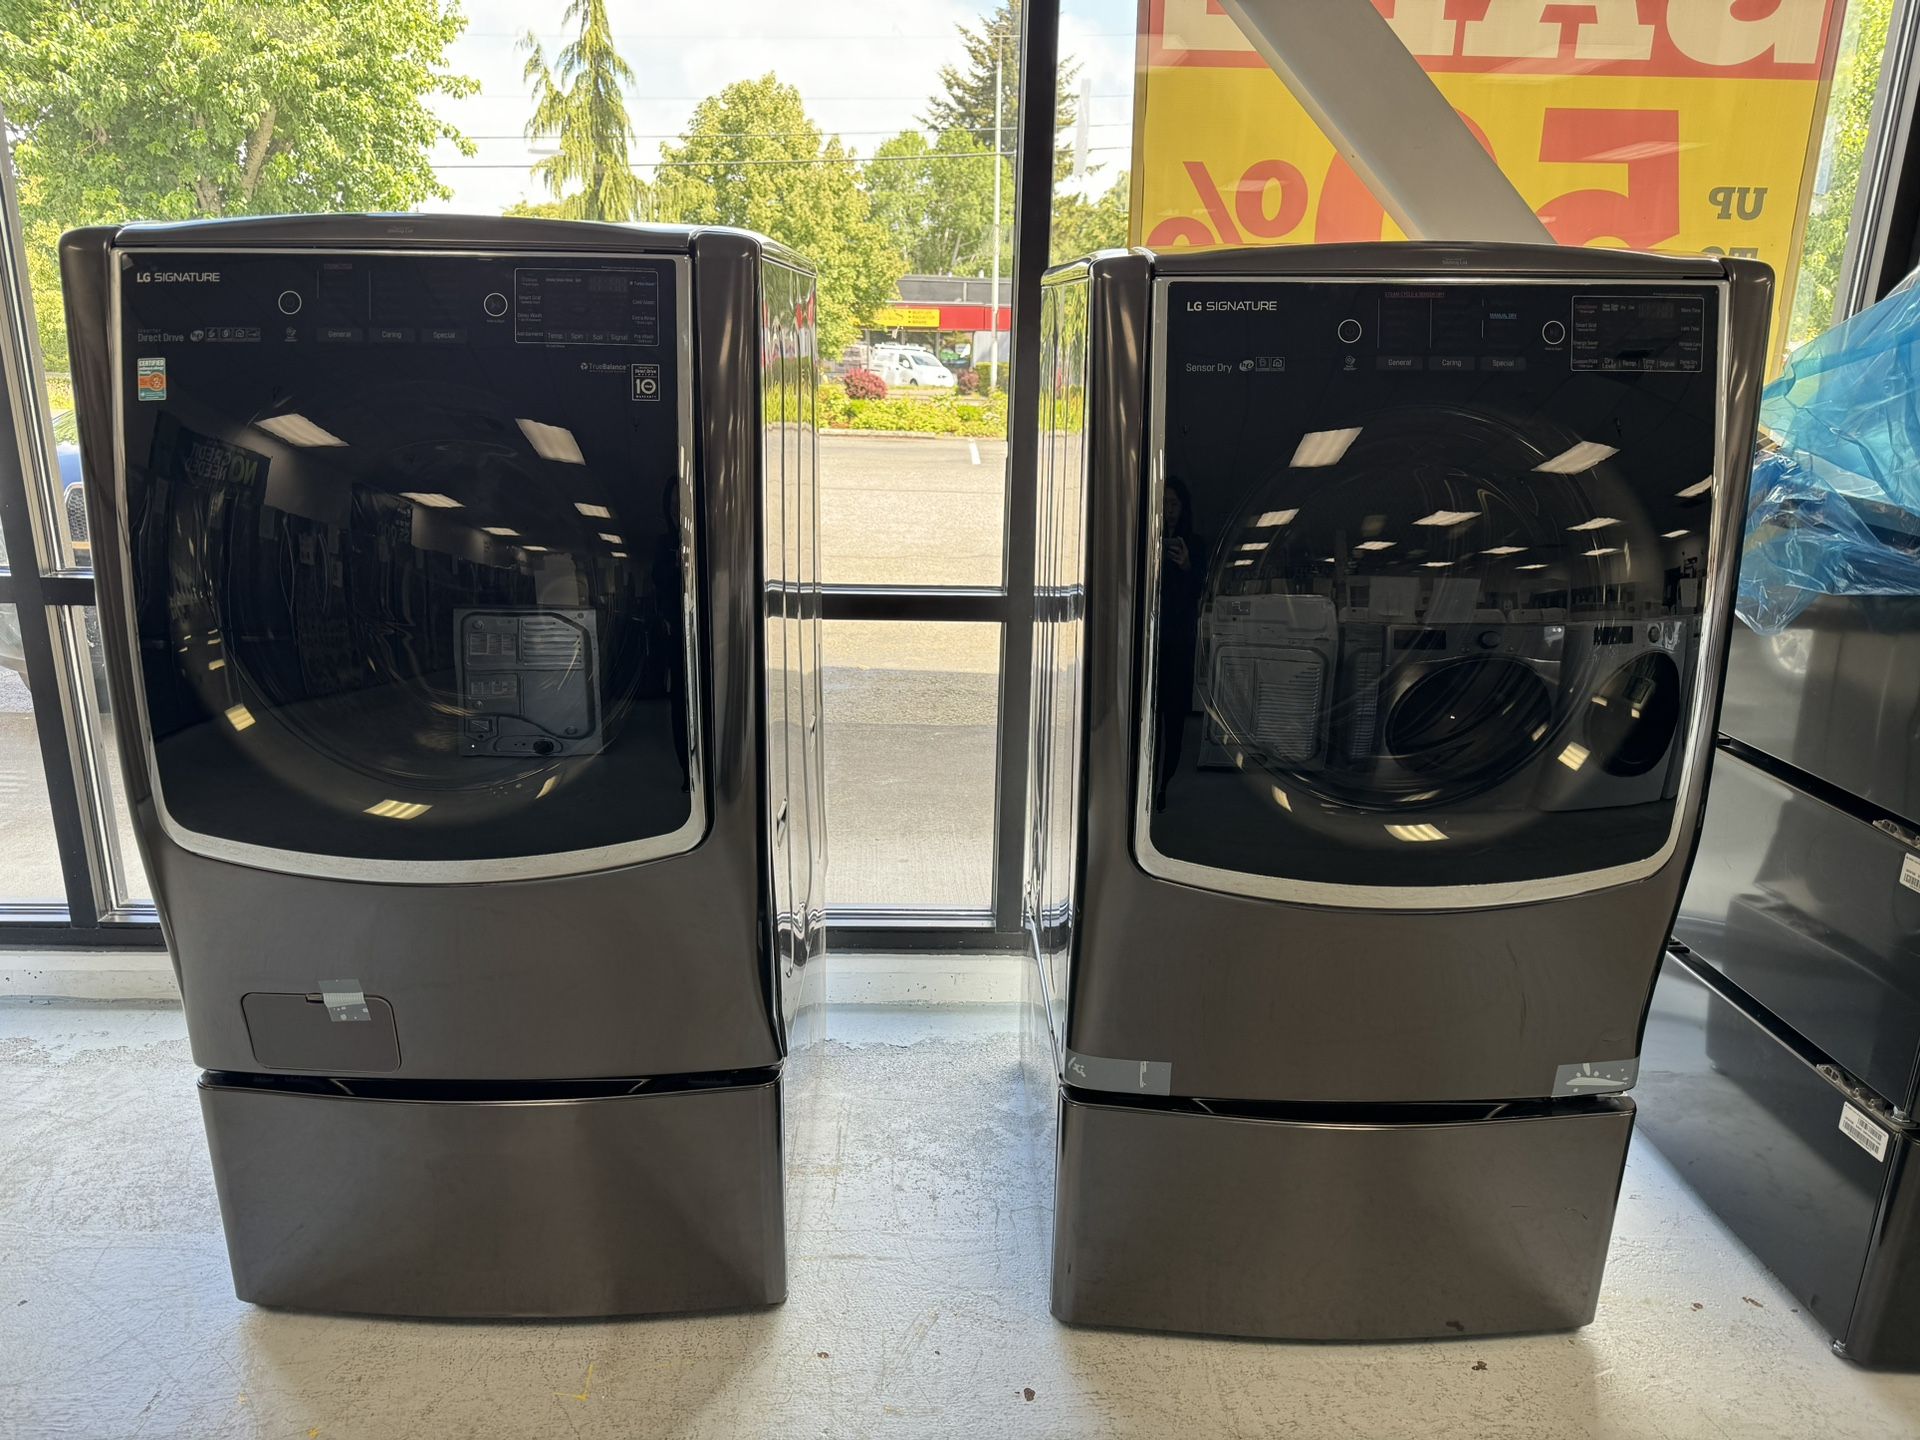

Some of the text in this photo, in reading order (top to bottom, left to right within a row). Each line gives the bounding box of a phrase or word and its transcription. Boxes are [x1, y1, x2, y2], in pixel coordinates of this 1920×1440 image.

[136, 272, 221, 283] LG SIGNATURE
[1186, 301, 1278, 312] LG SIGNATURE
[138, 333, 161, 342] Direct
[163, 333, 184, 342] Drive
[328, 330, 352, 339] General
[382, 330, 402, 340] Caring
[432, 330, 456, 341] Special
[1388, 359, 1412, 367] General
[1441, 359, 1462, 368] Caring
[1492, 359, 1515, 369] Special
[1186, 363, 1215, 373] Sensor
[1217, 363, 1232, 374] Dry
[635, 378, 656, 394] 10
